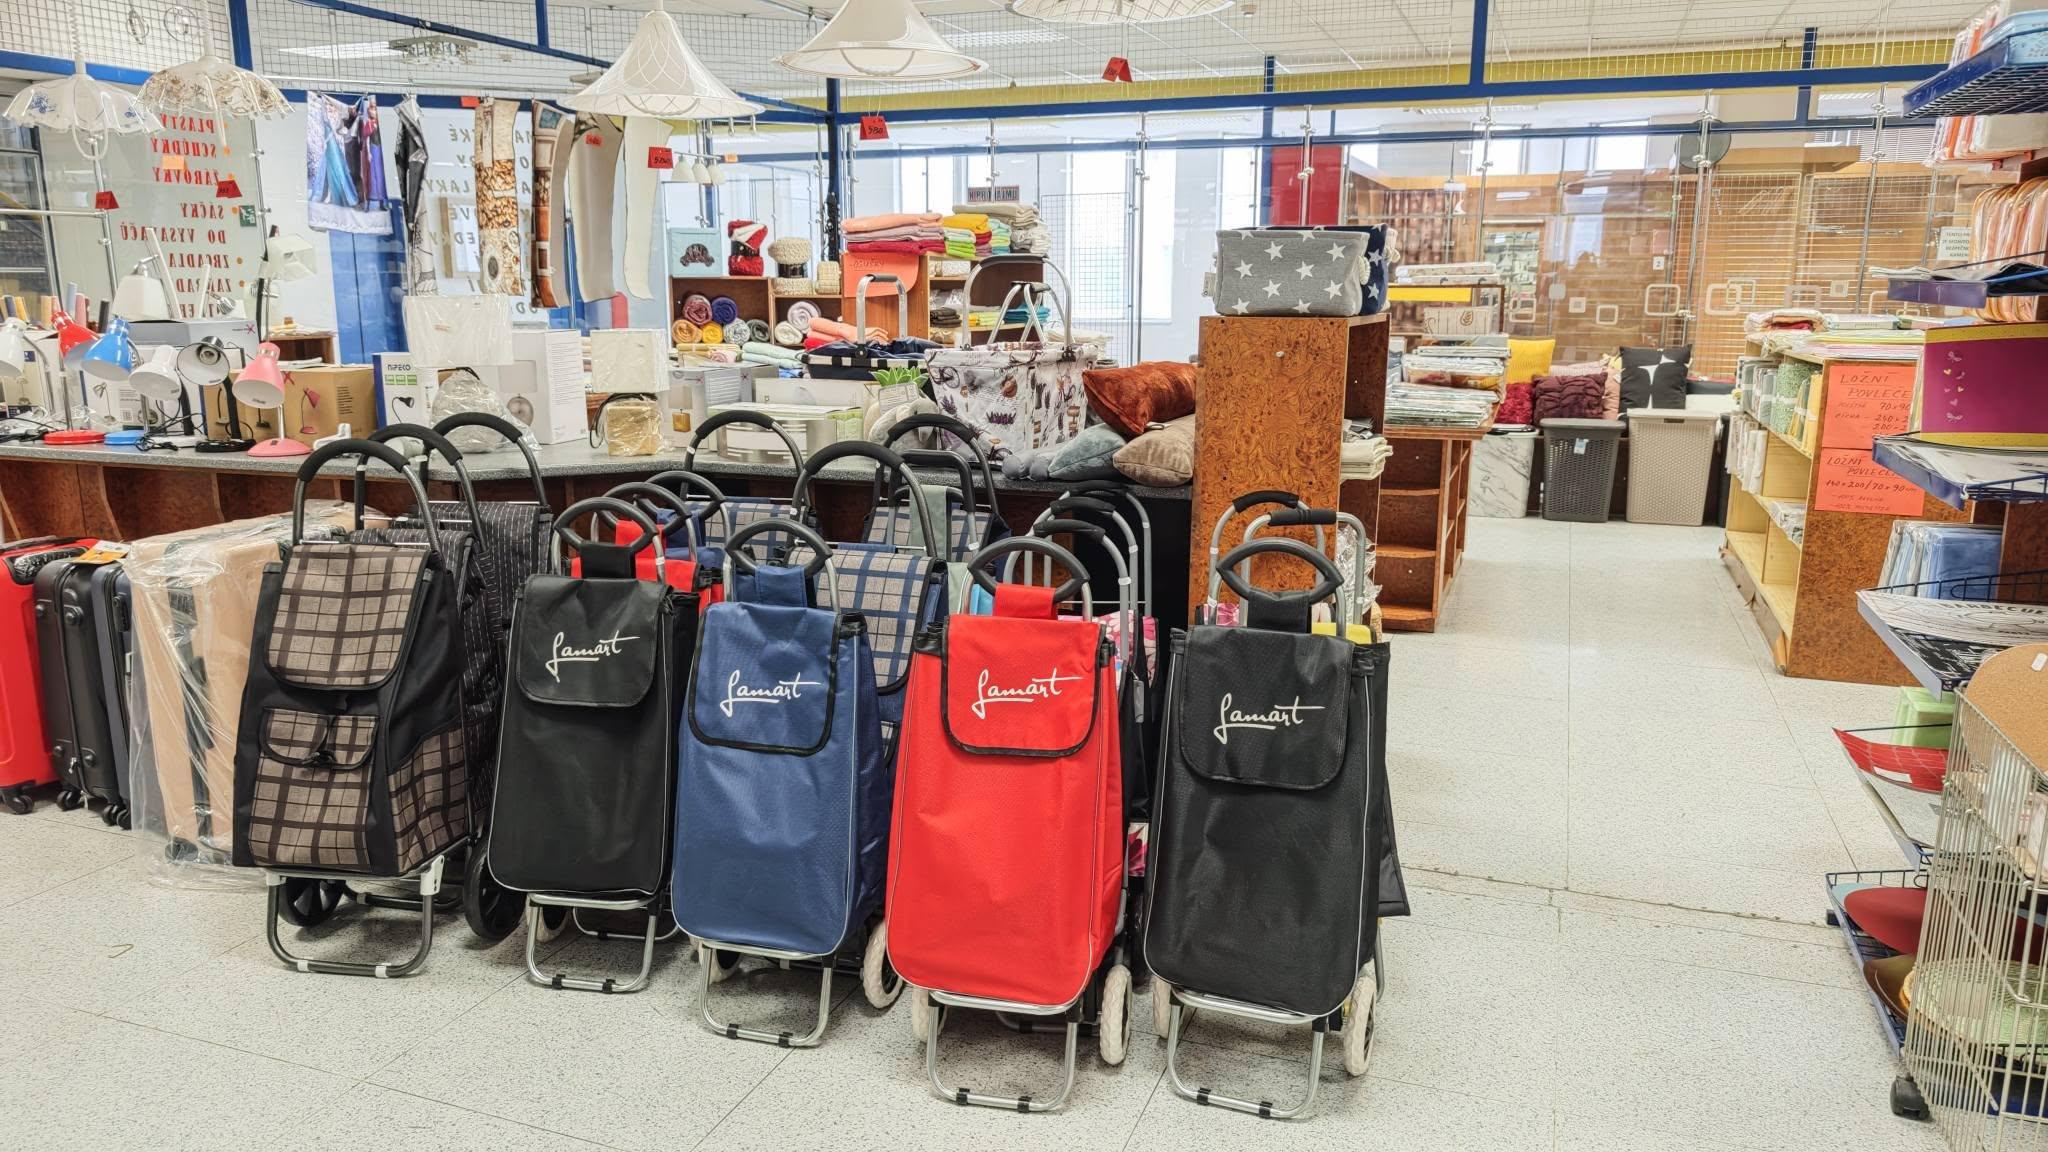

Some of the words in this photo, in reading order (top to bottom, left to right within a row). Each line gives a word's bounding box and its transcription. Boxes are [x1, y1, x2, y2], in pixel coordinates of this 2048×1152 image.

[545, 630, 640, 683] Lamart
[720, 670, 821, 718] Lamart
[972, 668, 1083, 720] Lamart
[1213, 692, 1325, 745] Lamart
